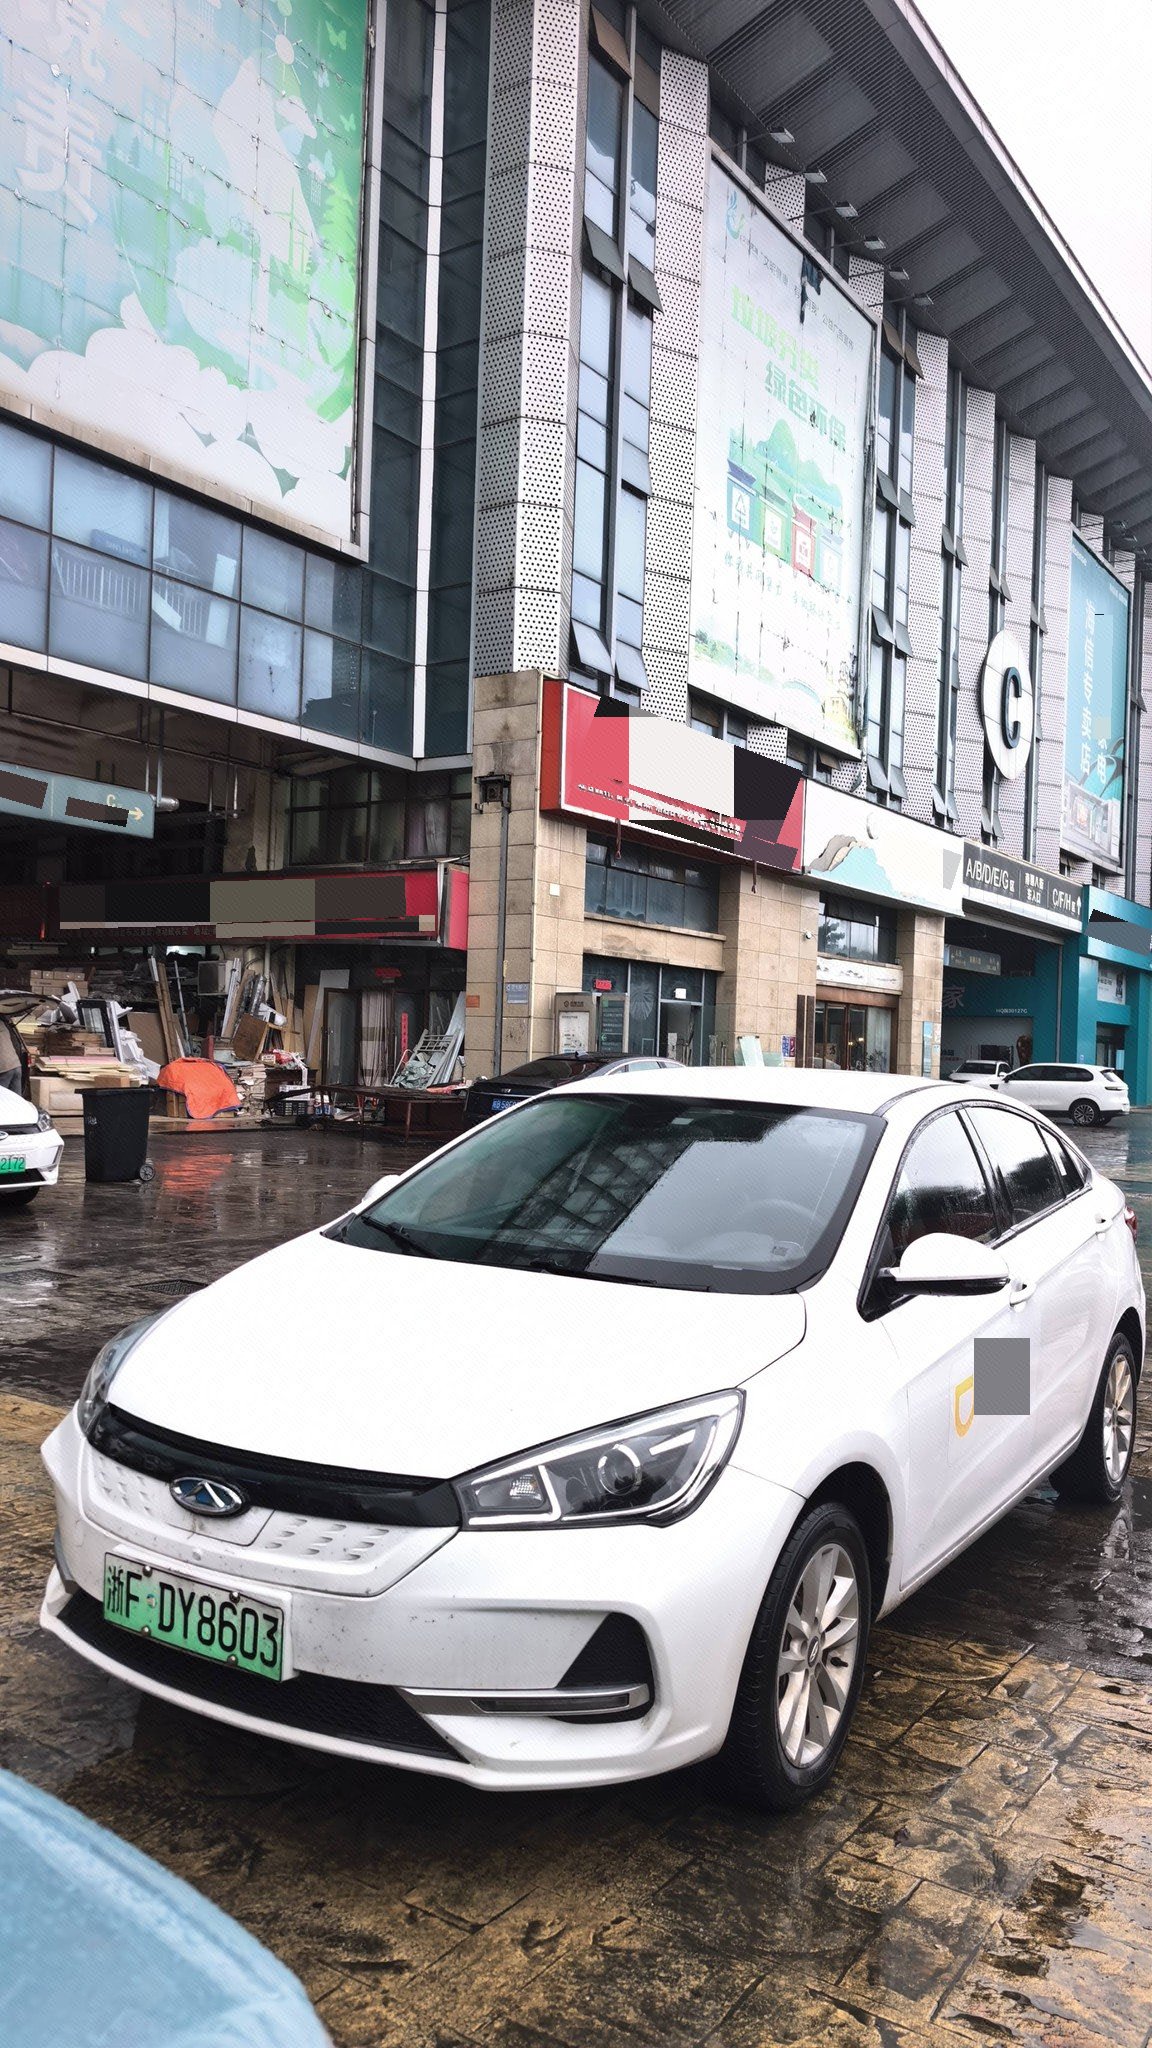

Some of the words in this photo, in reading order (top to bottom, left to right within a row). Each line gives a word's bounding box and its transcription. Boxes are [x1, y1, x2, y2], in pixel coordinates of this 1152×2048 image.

[731, 283, 819, 392] 垃圾分类
[765, 359, 847, 452] 绿色环保
[1002, 667, 1022, 749] C
[157, 1581, 280, 1669] DY8603
